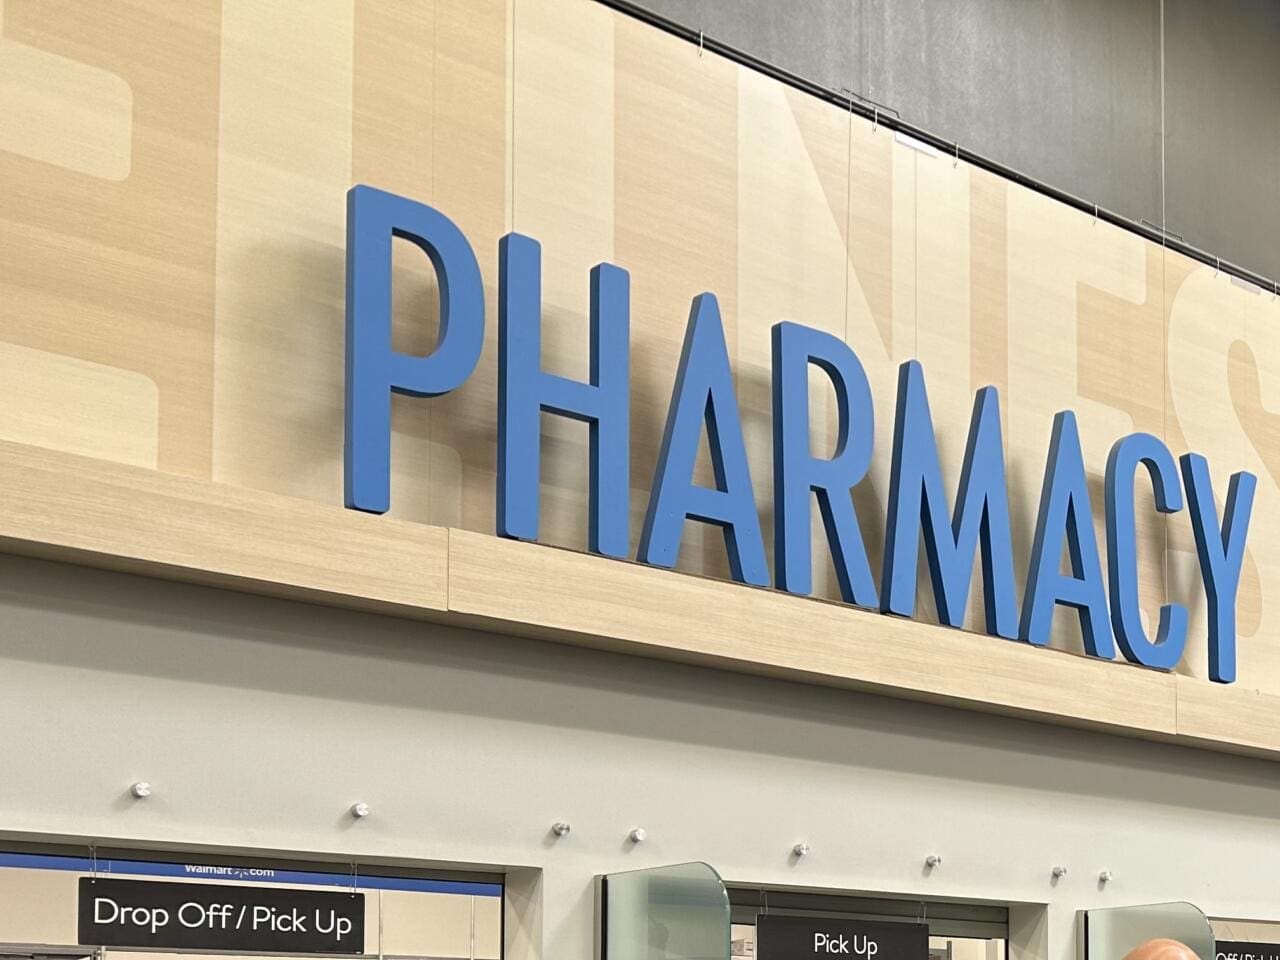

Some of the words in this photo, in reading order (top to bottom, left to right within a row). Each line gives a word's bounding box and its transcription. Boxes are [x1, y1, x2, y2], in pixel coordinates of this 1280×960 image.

[344, 184, 1256, 682] PHARMACY
[184, 864, 233, 876] Walmart
[94, 898, 169, 933] Drop
[178, 902, 233, 929] Off
[253, 906, 307, 933] Pick
[315, 909, 352, 941] Up
[814, 932, 849, 954] Pick
[854, 935, 878, 960] Up
